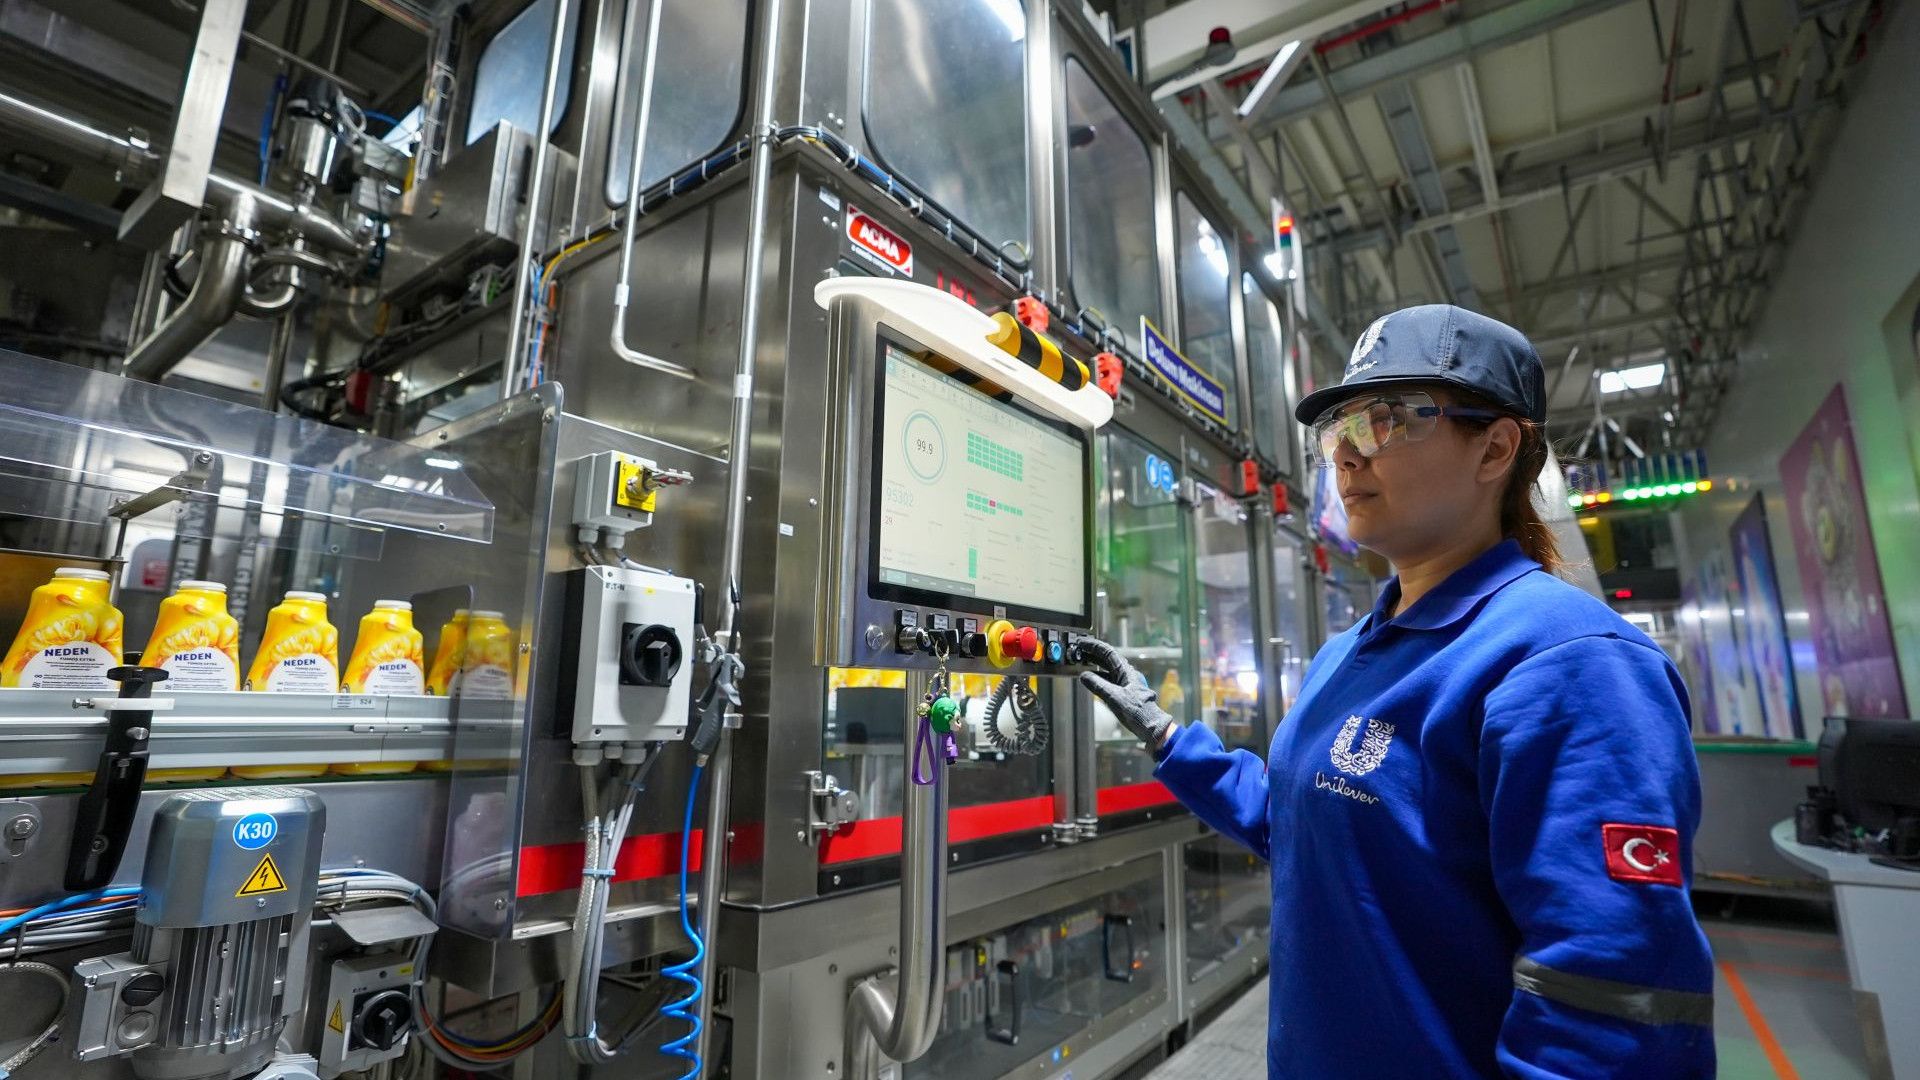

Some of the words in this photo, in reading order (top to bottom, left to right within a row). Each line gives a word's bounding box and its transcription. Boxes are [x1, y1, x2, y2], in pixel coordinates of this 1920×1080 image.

[858, 222, 900, 262] ACMA
[1148, 335, 1178, 381] Dolum
[916, 438, 933, 455] 99.9
[44, 647, 89, 657] NEDEN
[174, 652, 212, 661] NEDEN
[283, 658, 316, 667] NEDEN
[379, 663, 407, 671] NEDEN
[1315, 771, 1380, 805] Unilever
[238, 821, 273, 841] K30
